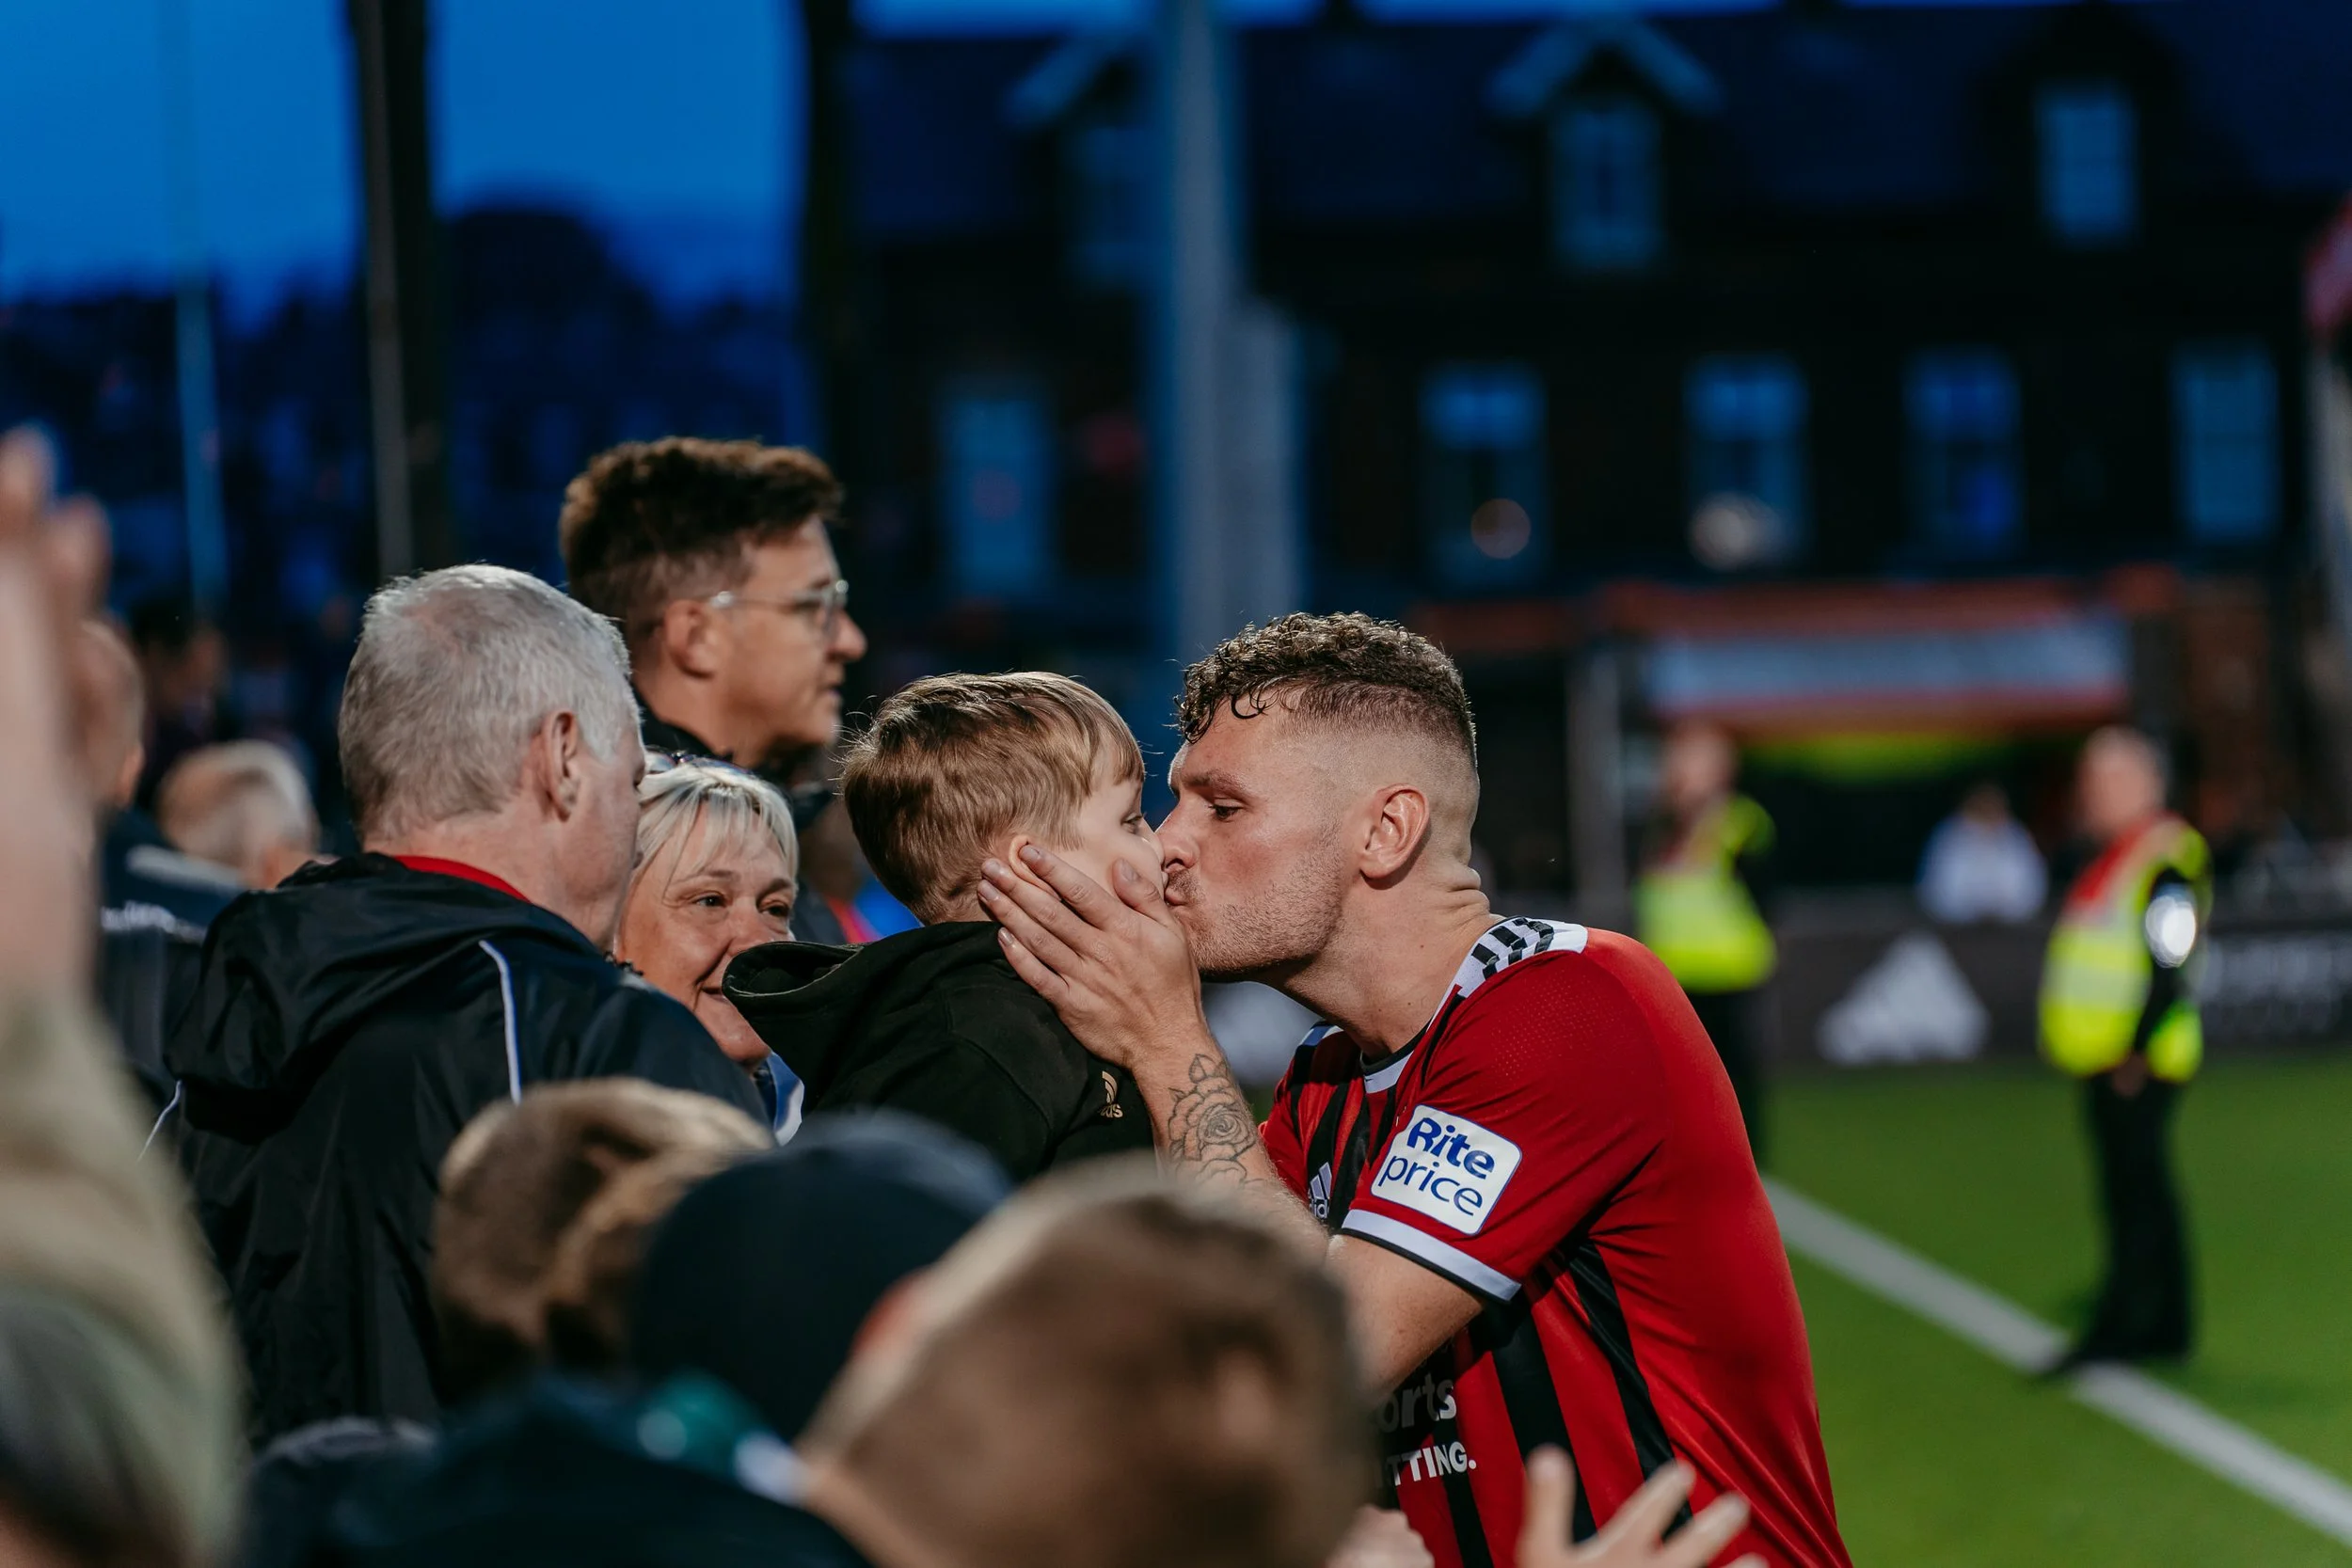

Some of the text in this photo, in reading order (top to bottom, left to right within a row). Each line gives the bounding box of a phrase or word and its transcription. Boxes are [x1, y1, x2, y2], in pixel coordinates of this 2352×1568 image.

[1406, 1117, 1495, 1180] Rite
[1377, 1155, 1483, 1216] price
[1376, 1371, 1457, 1433] orts
